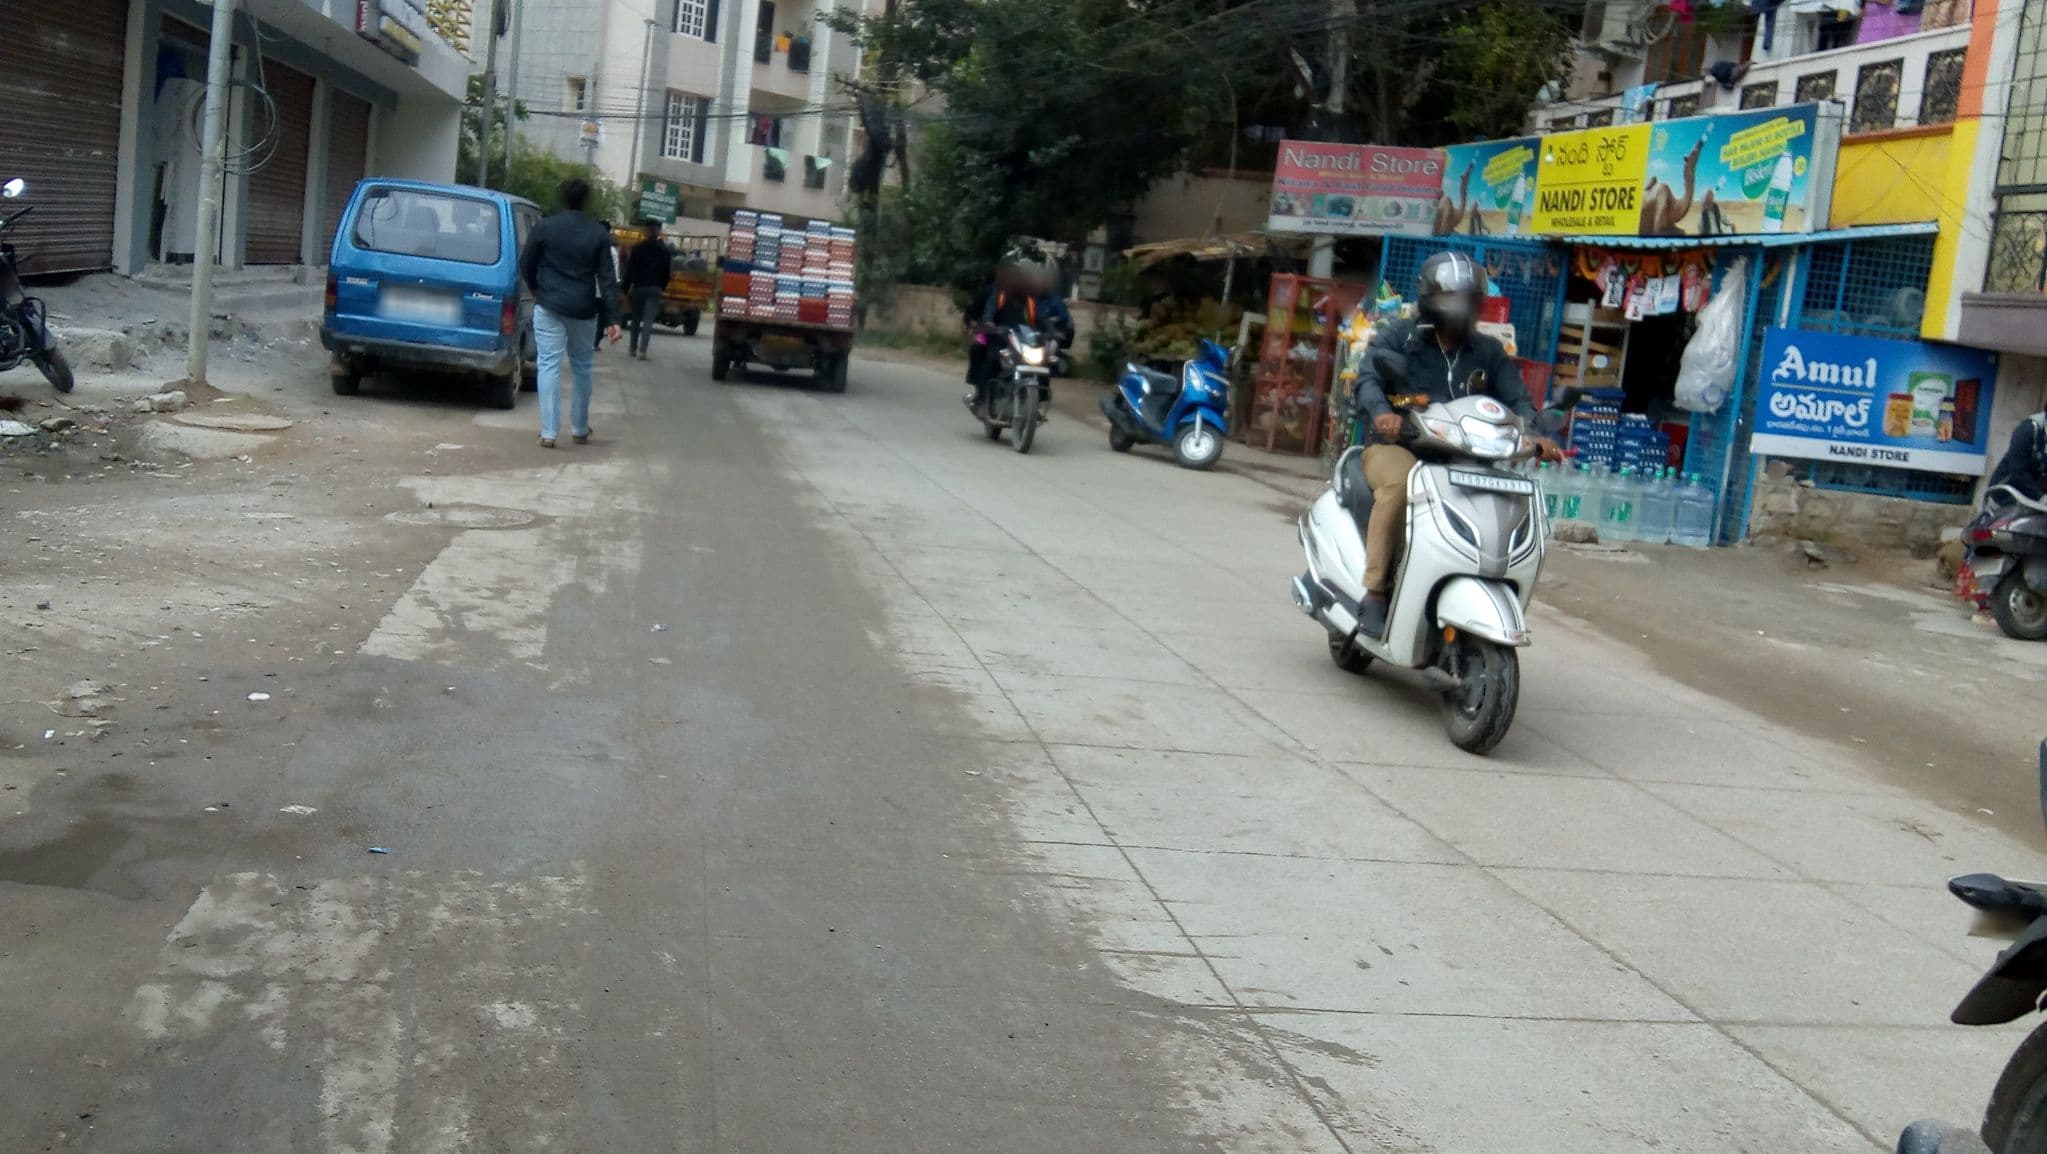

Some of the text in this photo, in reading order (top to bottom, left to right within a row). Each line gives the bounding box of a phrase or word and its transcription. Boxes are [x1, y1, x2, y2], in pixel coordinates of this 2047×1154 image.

[1283, 146, 1361, 171] Nandi
[1370, 152, 1439, 177] Store
[1557, 134, 1629, 176] నంది స్టోర్
[1540, 186, 1636, 213] NANDI STORE
[1772, 345, 1878, 389] Amul
[1769, 391, 1873, 428] అమూల్
[1829, 444, 1910, 463] NANDI STORE
